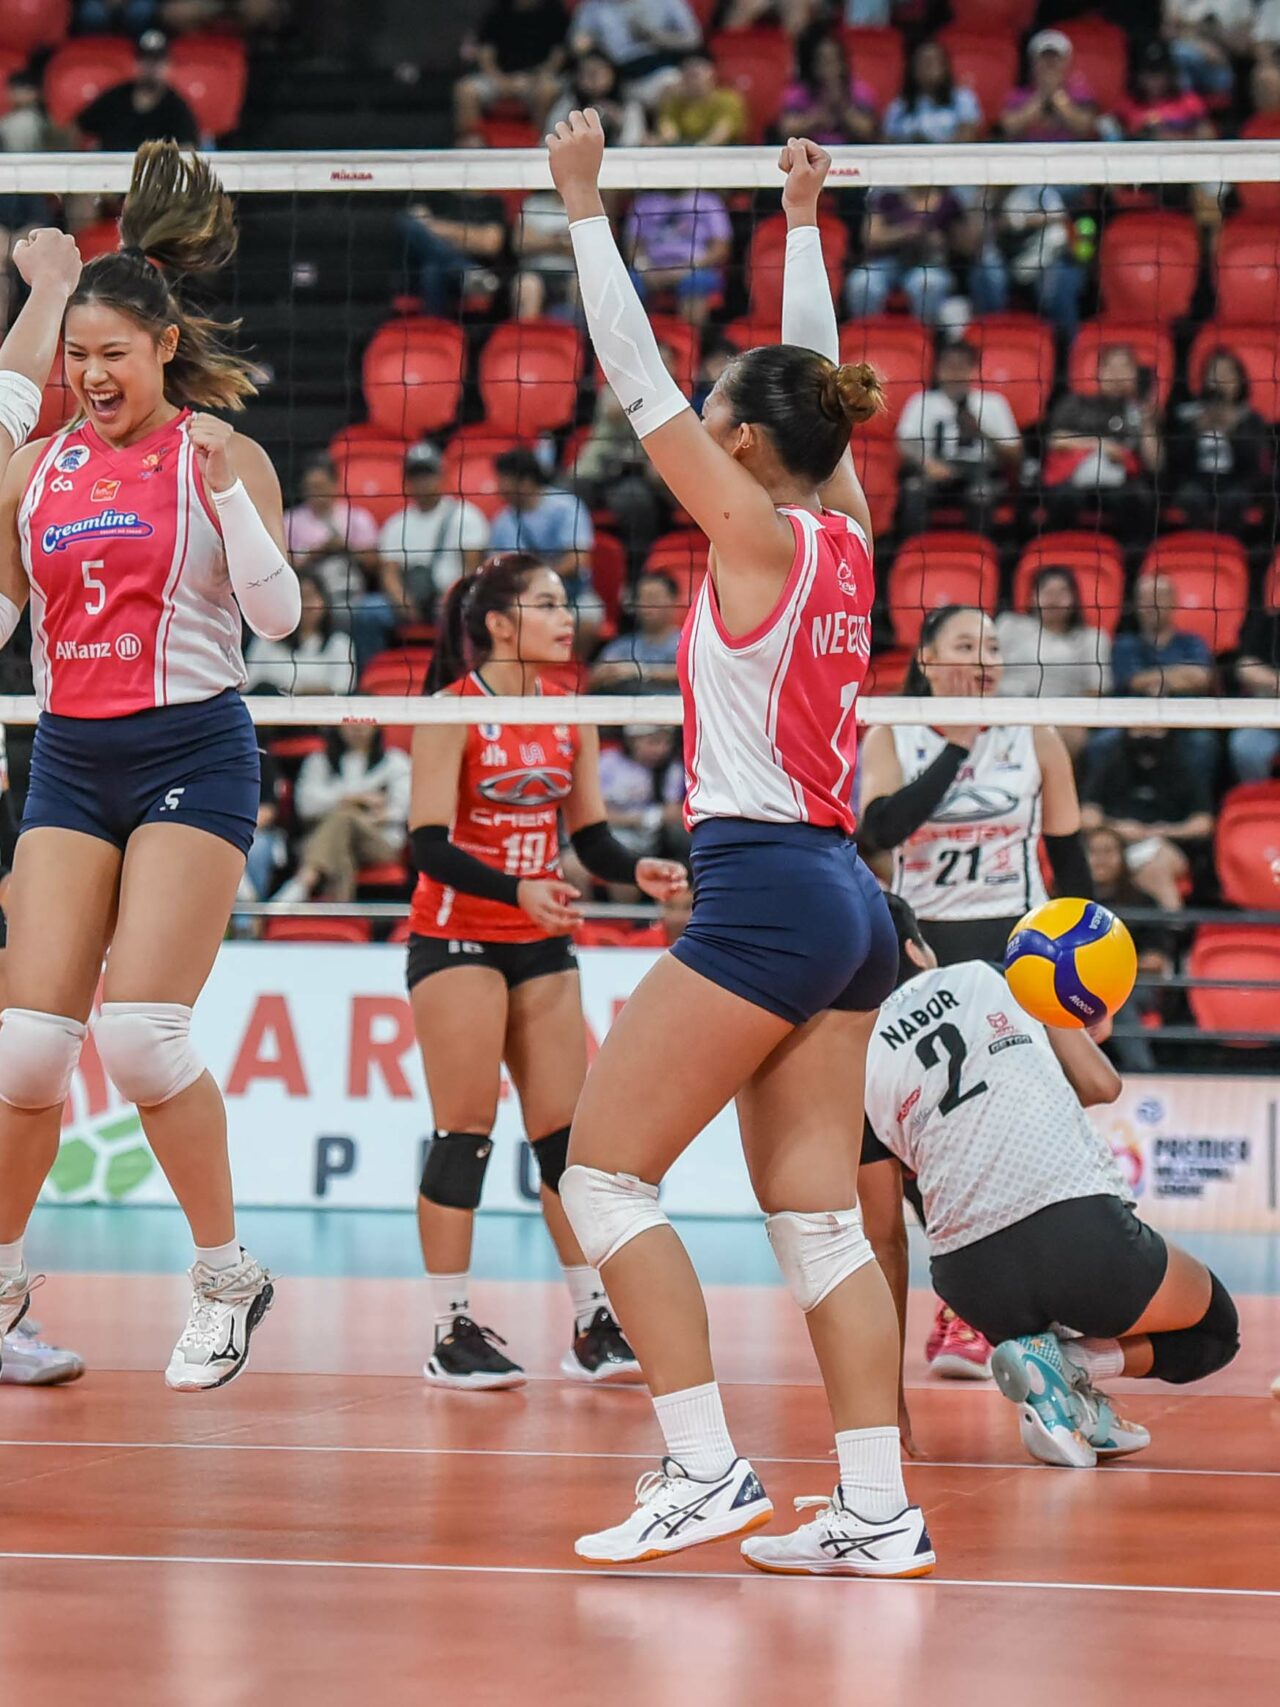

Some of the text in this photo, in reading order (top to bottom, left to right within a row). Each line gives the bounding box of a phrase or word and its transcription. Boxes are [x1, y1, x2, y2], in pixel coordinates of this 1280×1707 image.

[43, 511, 137, 551] Creamline
[81, 559, 106, 616] 5
[55, 640, 112, 661] Allianz
[935, 845, 981, 887] 21
[879, 989, 961, 1051] NABOR
[914, 1021, 990, 1118] 2
